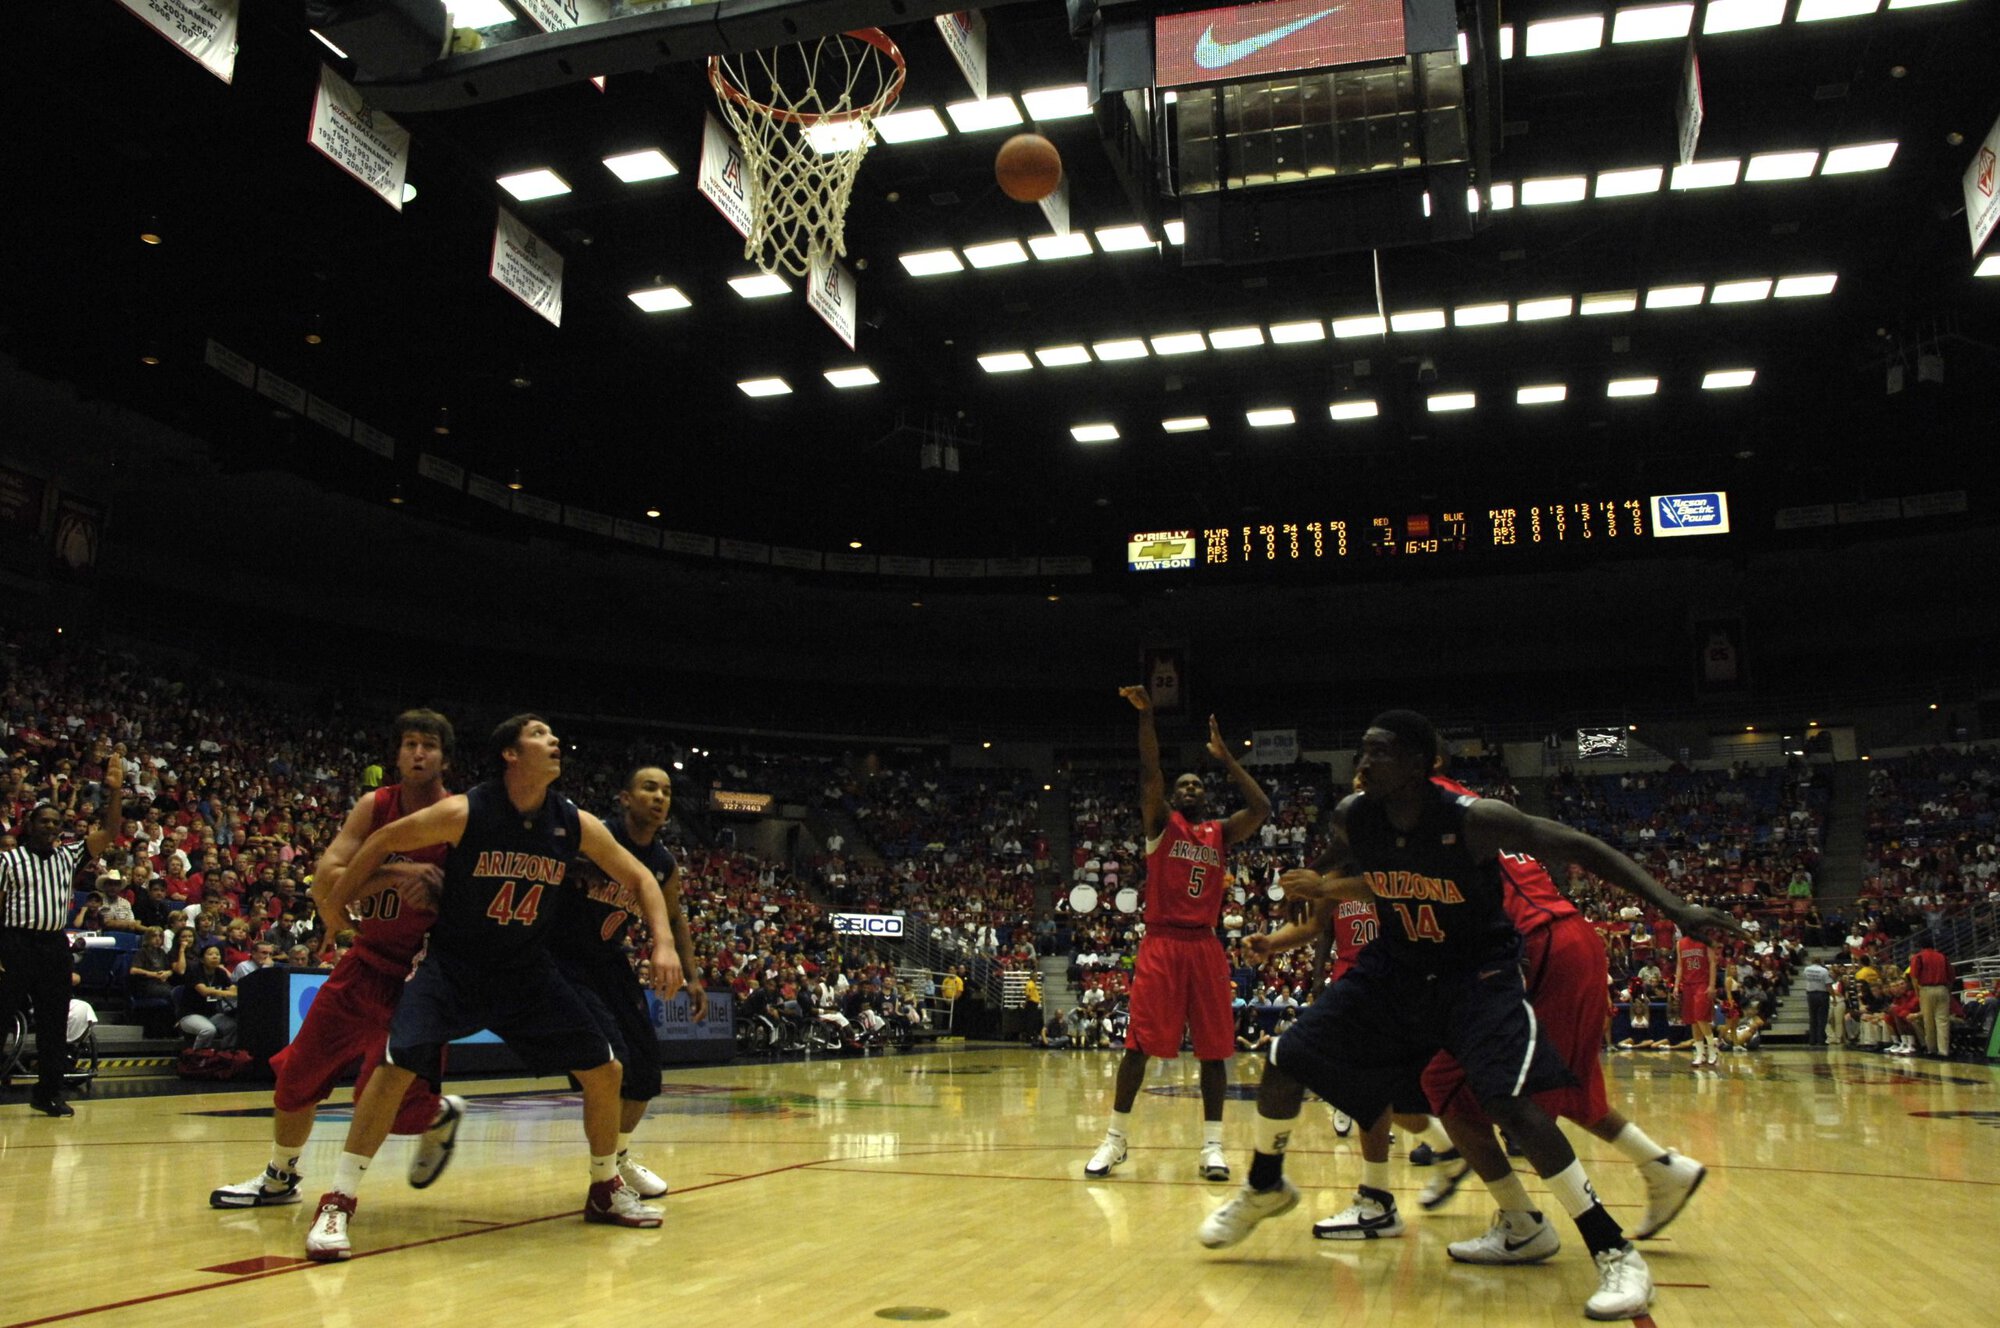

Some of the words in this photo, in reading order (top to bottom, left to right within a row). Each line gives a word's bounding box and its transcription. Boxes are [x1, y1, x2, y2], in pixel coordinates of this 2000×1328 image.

[330, 117, 349, 135] NCAA
[1489, 508, 1516, 519] PLYR
[1531, 507, 1539, 516] 0
[1574, 503, 1590, 513] 13
[1599, 501, 1615, 511] 14
[1623, 500, 1640, 509] 44
[1672, 499, 1707, 507] Tucson
[1677, 505, 1715, 515] Electric
[1373, 517, 1389, 527] RED
[1443, 512, 1465, 522] BLUE
[1494, 518, 1513, 527] PTS
[1606, 510, 1616, 519] 6
[1632, 508, 1641, 517] 0
[1681, 514, 1715, 523] Power
[1204, 528, 1229, 538] PLYR
[1243, 526, 1251, 535] 5
[1259, 525, 1274, 535] 20
[1283, 523, 1298, 534] 34
[1306, 522, 1322, 532] 42
[1330, 521, 1346, 531] 50
[1383, 528, 1392, 541] 3
[1453, 523, 1466, 536] 11
[1494, 526, 1516, 536] RBS
[1532, 524, 1541, 533] 0
[1557, 523, 1566, 531] 0
[1607, 519, 1616, 528] 3
[1633, 517, 1642, 526] 2
[1133, 531, 1189, 542] O'RIELLY
[1208, 538, 1226, 546] PTS
[1267, 533, 1275, 542] 0
[1314, 531, 1322, 540] 0
[1338, 530, 1346, 538] 0
[1494, 535, 1516, 545] FLS
[1533, 533, 1541, 542] 0
[1608, 528, 1617, 537] 0
[1633, 526, 1642, 535] 0
[1207, 546, 1228, 555] RBS
[1267, 542, 1275, 551] 0
[1290, 541, 1298, 549] 0
[1314, 540, 1322, 548] 0
[1338, 538, 1346, 547] 0
[1405, 539, 1438, 554] 16:43
[1207, 555, 1228, 564] FLS
[1267, 551, 1275, 560] 0
[1291, 549, 1299, 558] 0
[1315, 548, 1323, 557] 0
[1339, 547, 1347, 556] 0
[1135, 559, 1190, 570] WATSON
[1156, 676, 1174, 688] 32
[472, 851, 567, 885] ARIZONA
[1187, 865, 1207, 899] 5
[486, 880, 545, 926] 44
[600, 909, 628, 942] 0
[833, 917, 902, 933] GEICO
[1392, 902, 1446, 944] 14
[1351, 918, 1378, 947] 20
